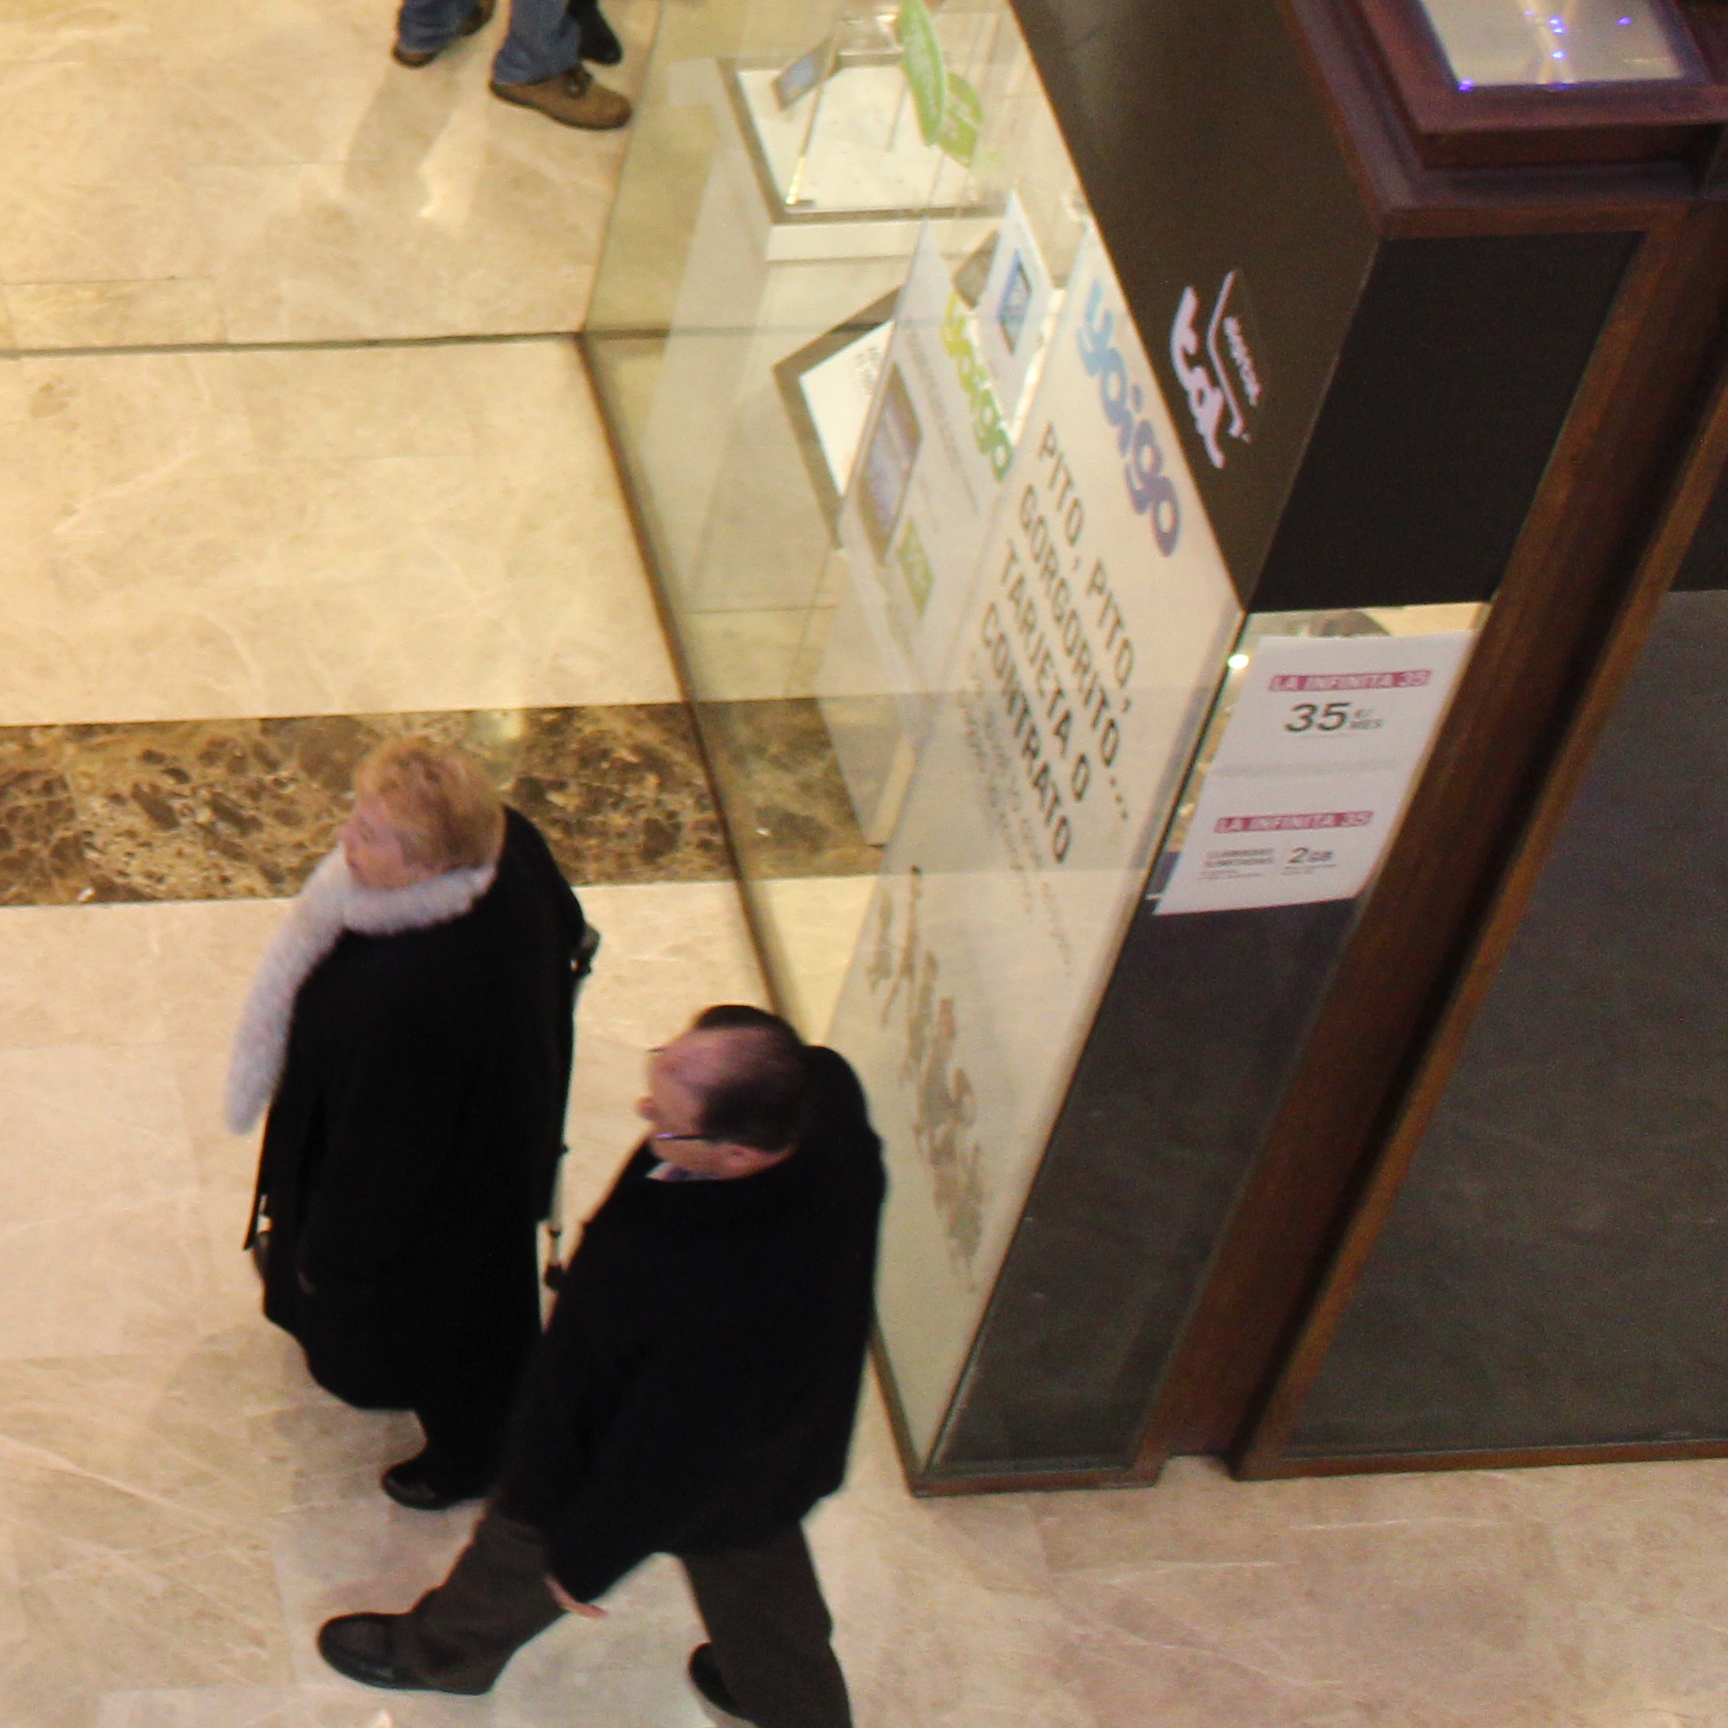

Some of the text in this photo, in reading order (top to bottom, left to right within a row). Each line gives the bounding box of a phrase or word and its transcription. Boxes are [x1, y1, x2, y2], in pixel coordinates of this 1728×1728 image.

[1076, 278, 1181, 559] yoigo
[981, 601, 1072, 865] CONTRATO
[1001, 538, 1073, 760] TARJETA
[1283, 701, 1352, 733] 35
